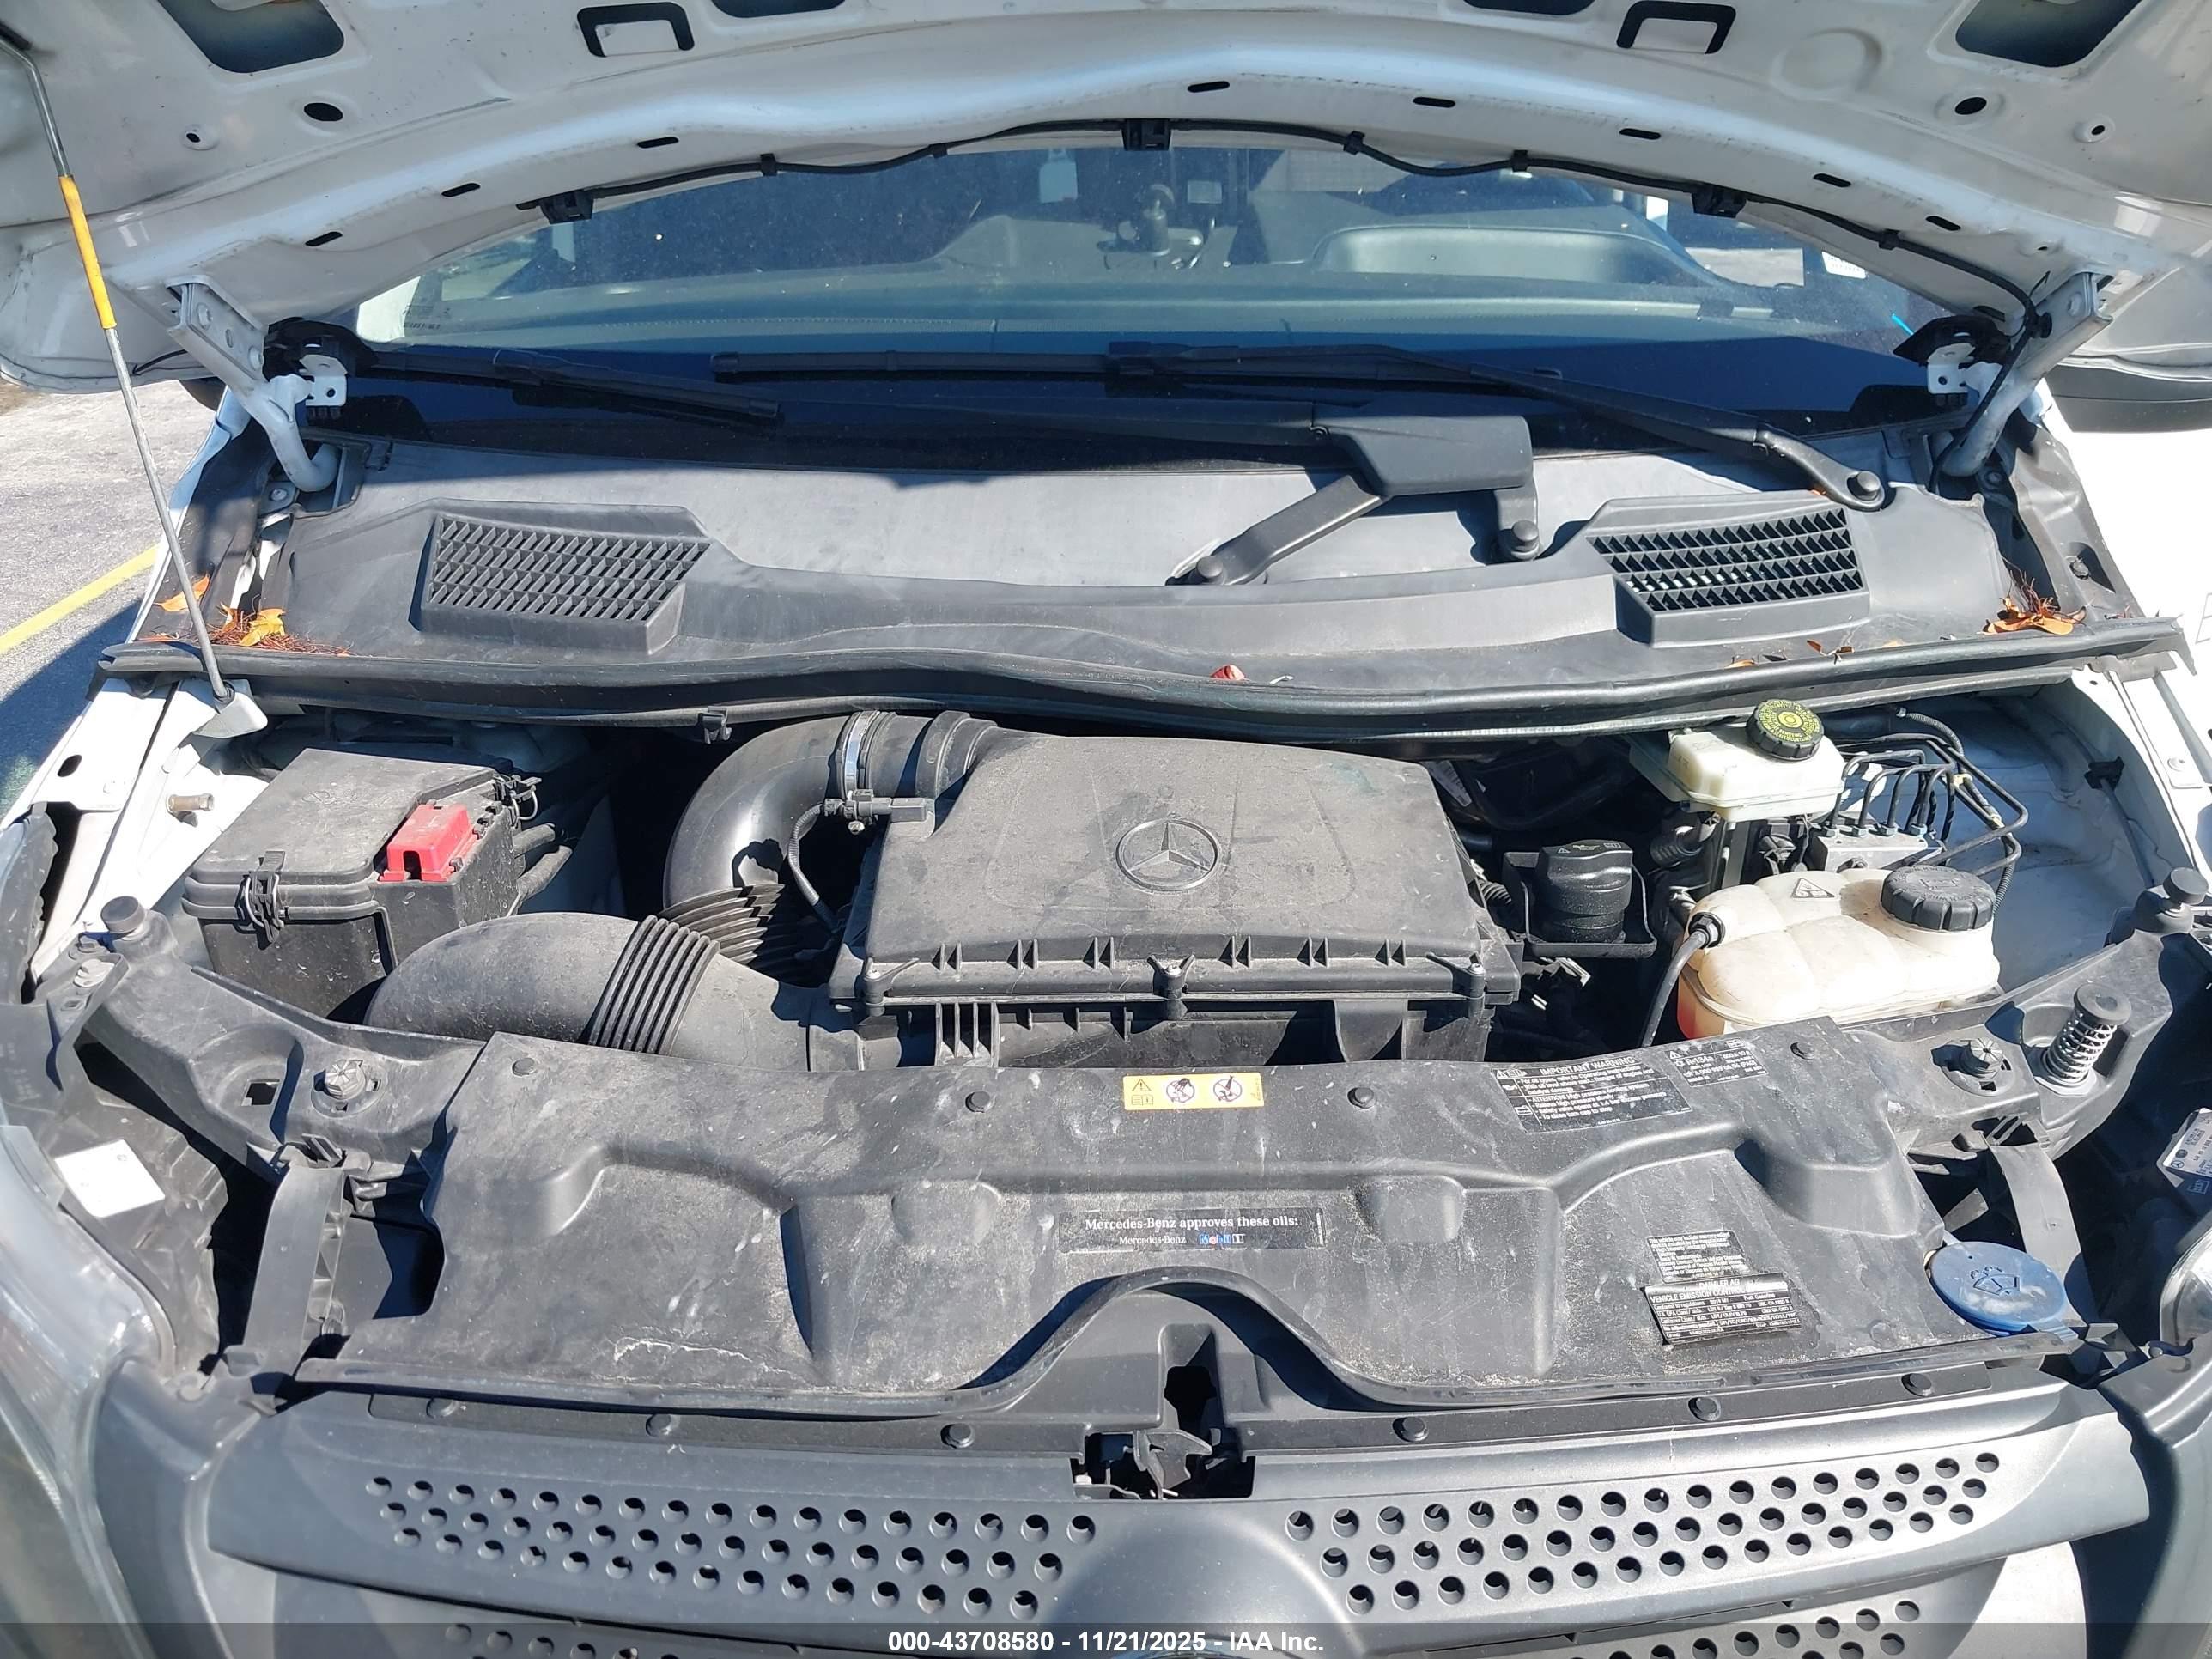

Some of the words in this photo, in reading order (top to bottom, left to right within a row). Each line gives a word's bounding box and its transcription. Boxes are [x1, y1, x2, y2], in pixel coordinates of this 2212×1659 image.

[1540, 1062, 1590, 1075] IMPORTANT
[1591, 1057, 1635, 1069] WARNING
[1085, 1218, 1176, 1230] Mercedes-Benz
[1180, 1218, 1234, 1231] approves
[1238, 1216, 1270, 1227] these
[1273, 1215, 1299, 1226] oils:
[1119, 1236, 1186, 1245] Mercedes-Benz
[1699, 1279, 1729, 1290] DAIMLER
[1650, 1293, 1679, 1303] VEHICLE
[1679, 1289, 1712, 1300] EMISSION
